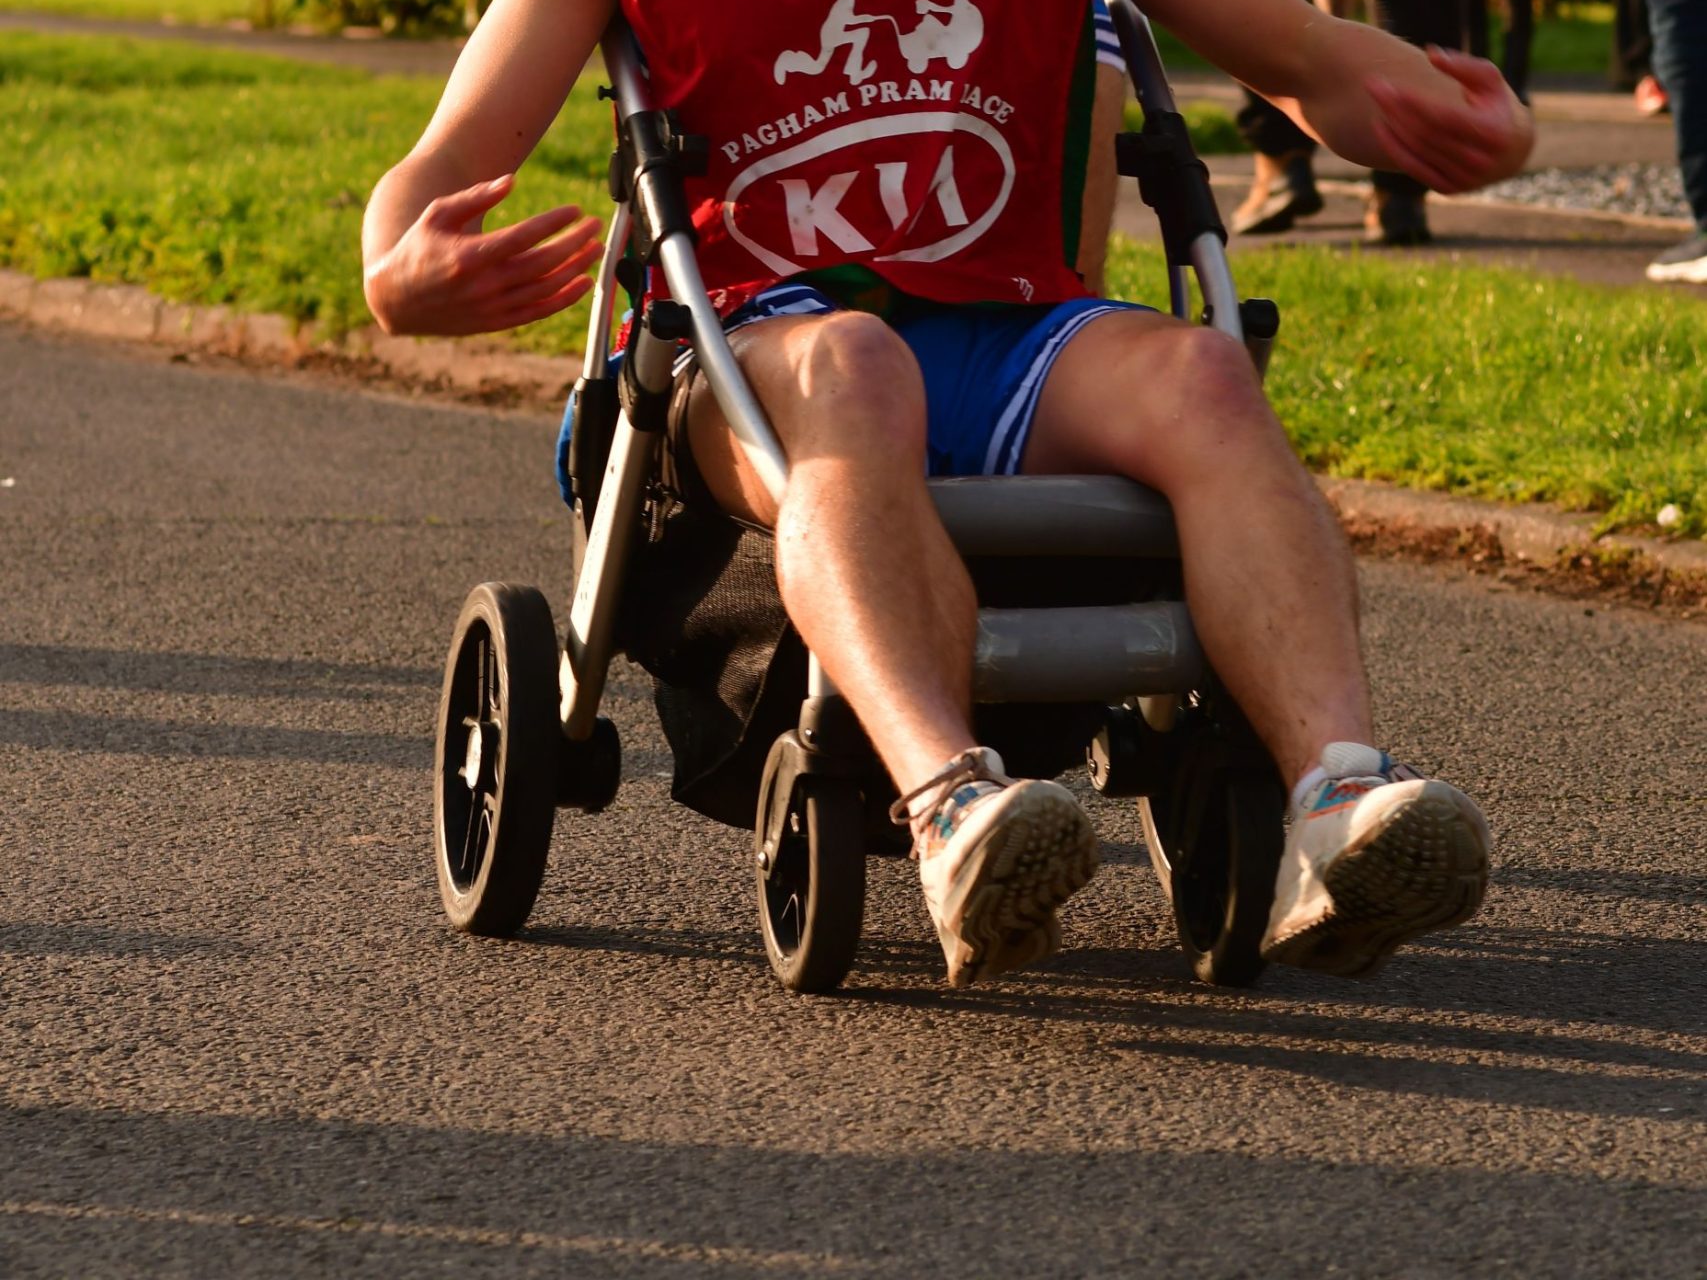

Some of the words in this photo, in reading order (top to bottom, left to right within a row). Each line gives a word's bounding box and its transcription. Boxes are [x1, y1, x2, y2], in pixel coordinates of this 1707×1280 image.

[720, 91, 851, 164] PAGHAM
[857, 78, 955, 107] PRAM
[775, 144, 969, 257] KIA
